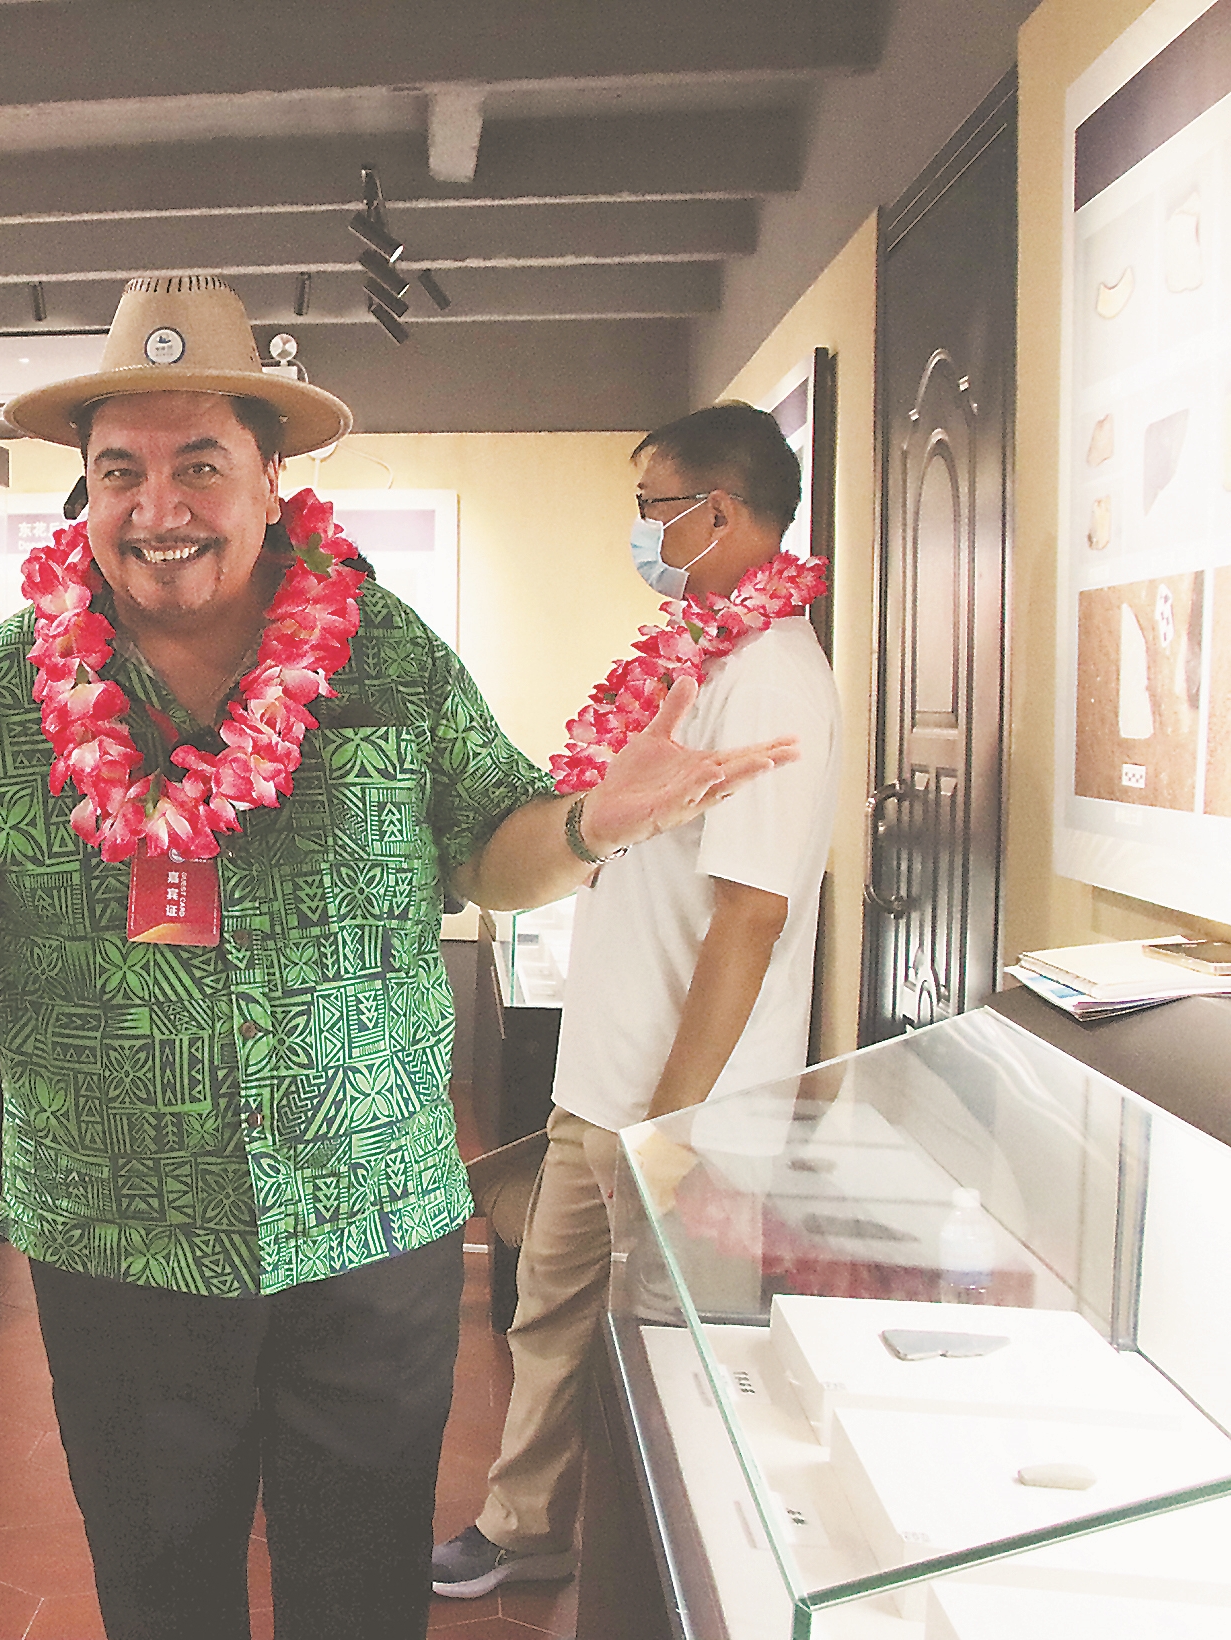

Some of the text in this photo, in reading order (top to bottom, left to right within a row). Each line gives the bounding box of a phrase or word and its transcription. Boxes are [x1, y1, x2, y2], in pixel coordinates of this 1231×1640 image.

[165, 870, 180, 917] 嘉宾证
[179, 871, 188, 918] GUEST CARD
